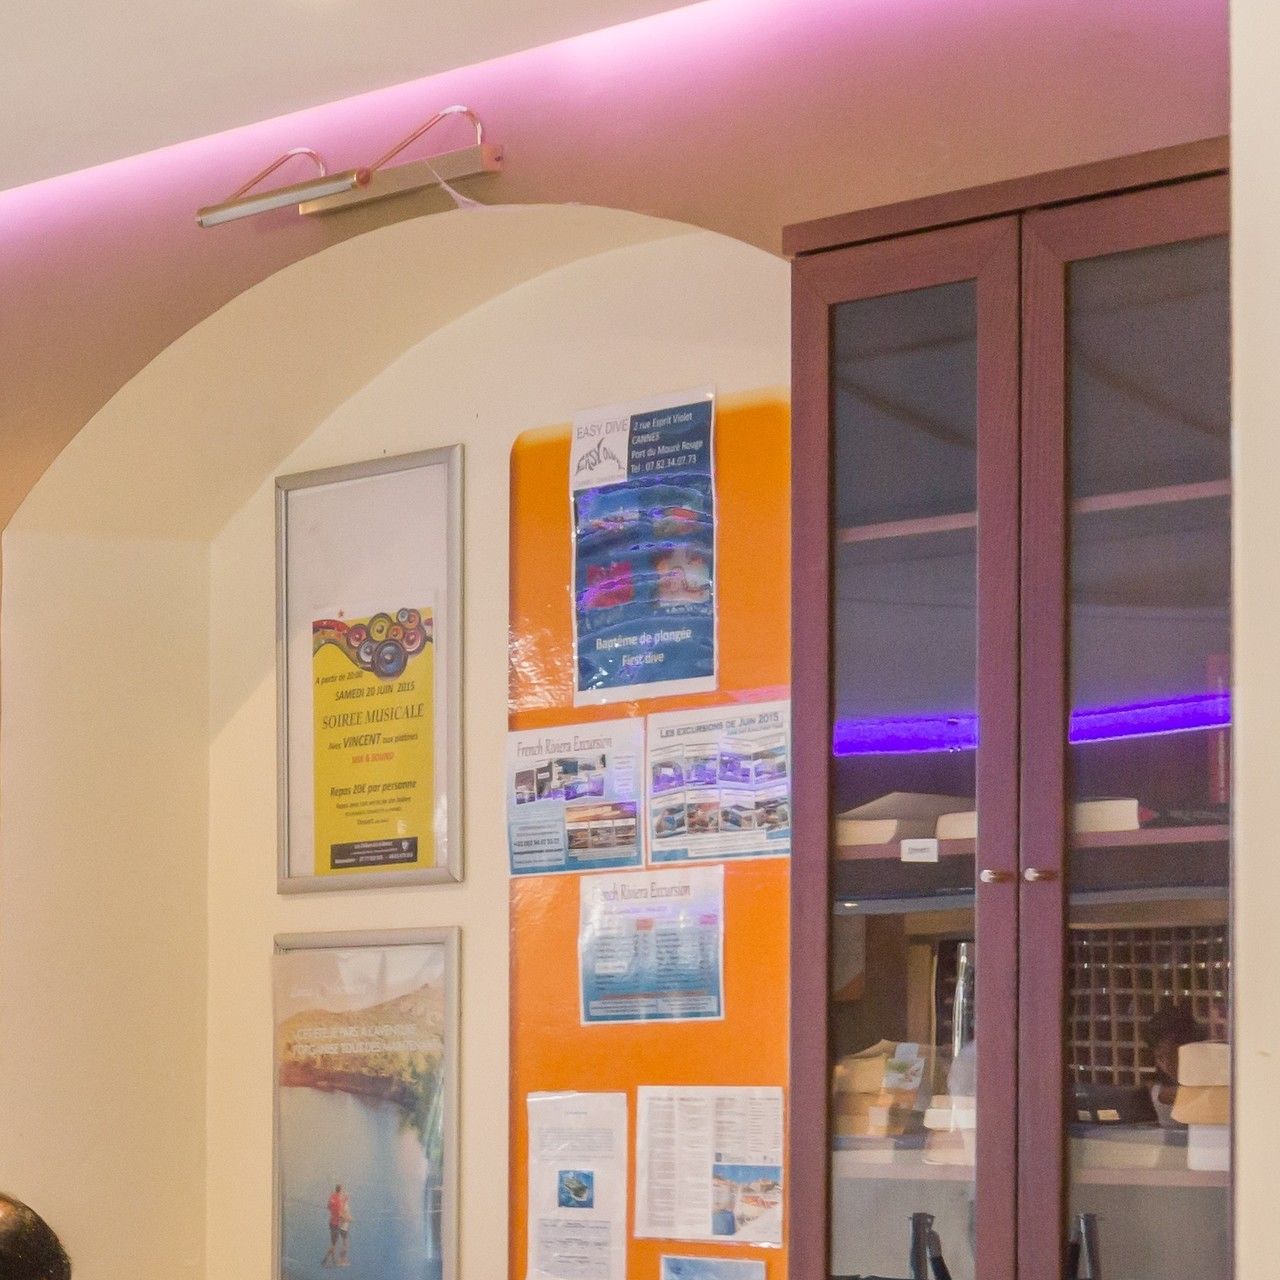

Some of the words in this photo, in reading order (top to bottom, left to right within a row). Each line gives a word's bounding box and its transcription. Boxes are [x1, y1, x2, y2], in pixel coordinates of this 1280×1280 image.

[576, 423, 604, 440] EASY
[605, 417, 629, 435] DIVE
[335, 687, 364, 701] SAMEDI
[322, 711, 363, 730] SOIREE
[365, 702, 424, 725] MUSICALE
[342, 733, 381, 748] VINCENT
